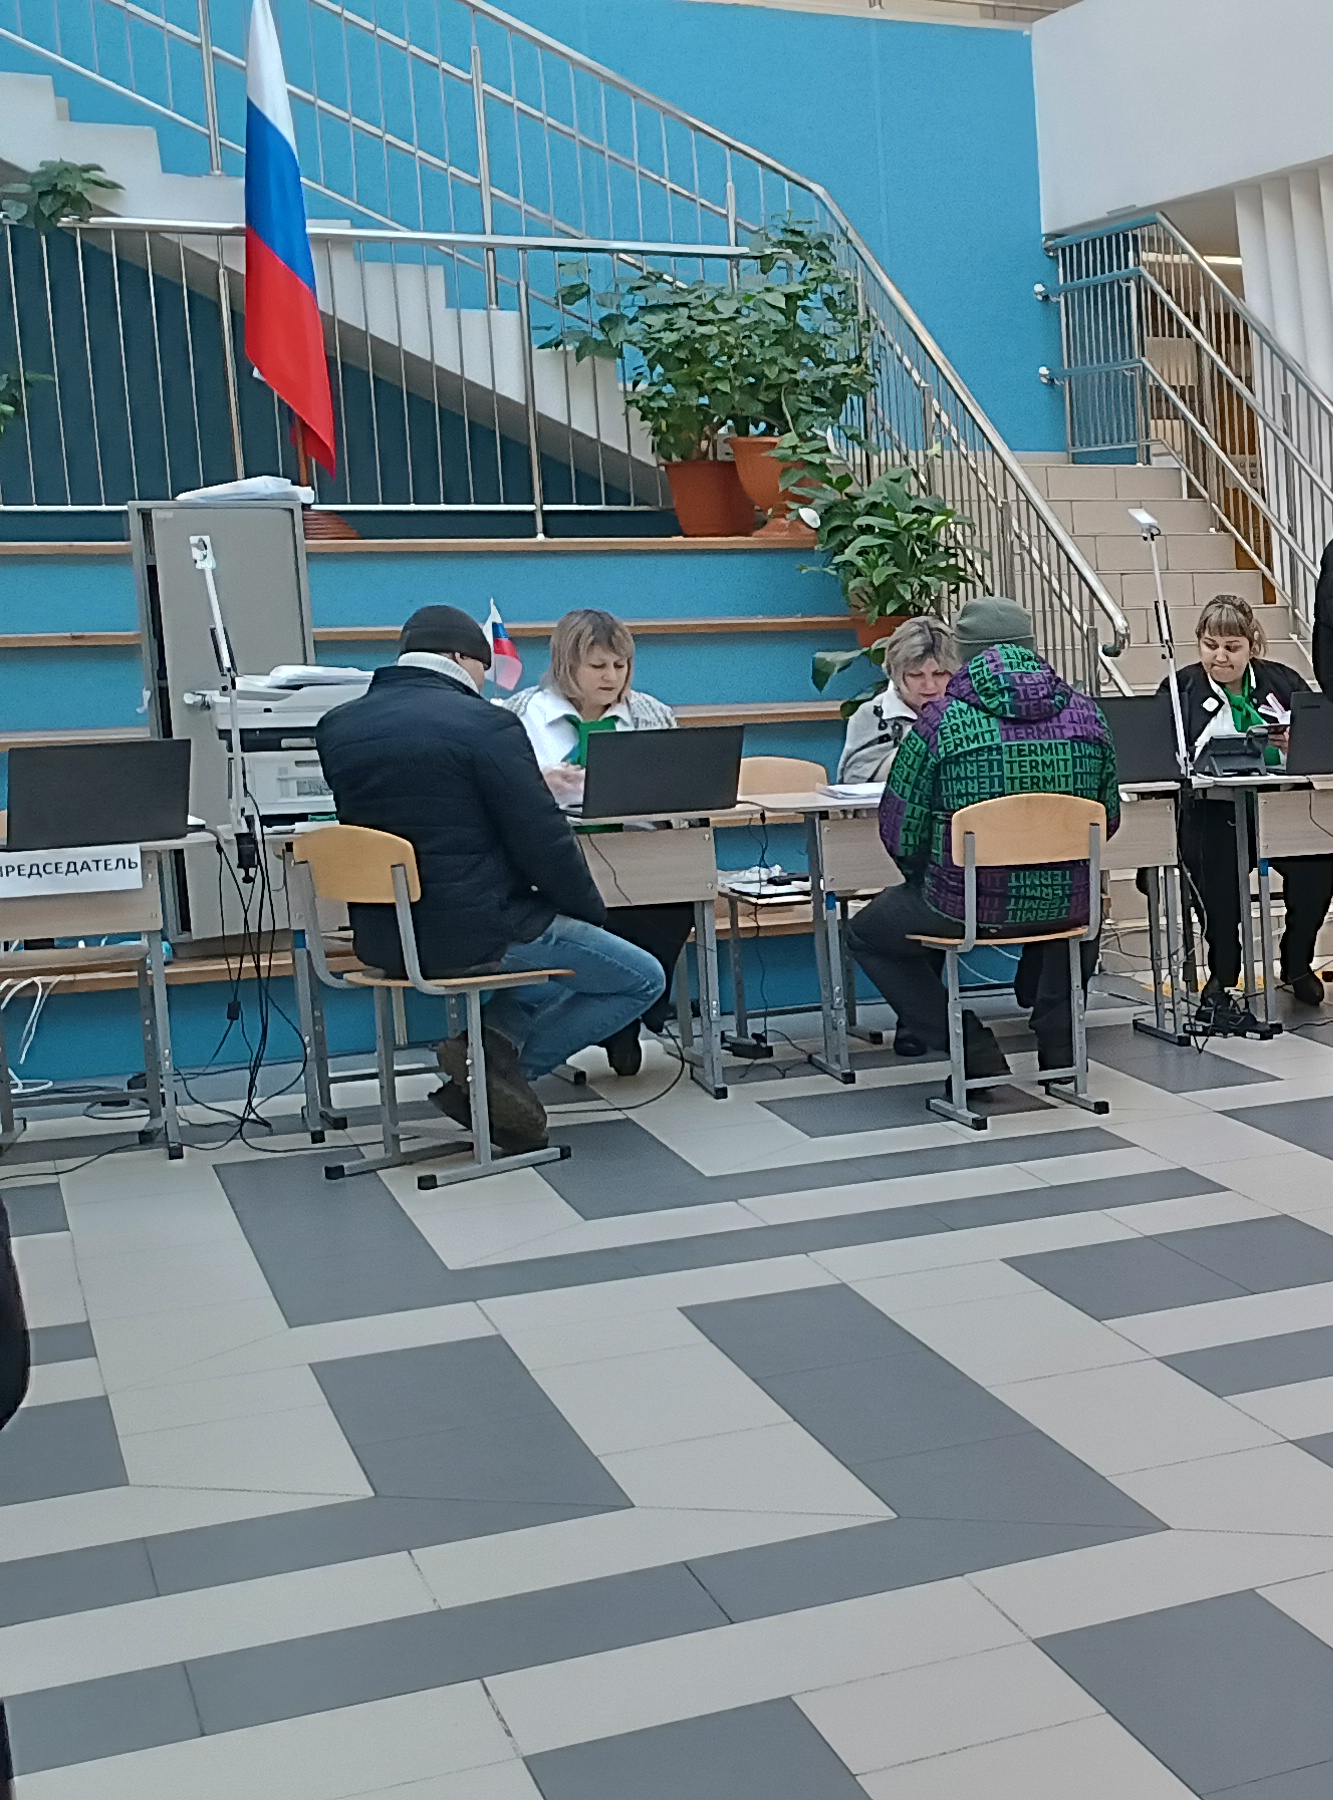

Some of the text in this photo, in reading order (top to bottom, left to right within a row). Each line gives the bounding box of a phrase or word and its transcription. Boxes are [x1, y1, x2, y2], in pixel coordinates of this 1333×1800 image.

[1001, 725, 1067, 740] TERMIT
[1004, 742, 1069, 758] TERMIT
[940, 761, 1003, 779] TERMIT
[1005, 758, 1070, 775] TERMIT
[941, 778, 1003, 796] TERMIT
[1006, 774, 1072, 791] TERMIT
[0, 857, 139, 879] РЕДСЕДАТЕЛЬ
[1007, 870, 1073, 886] TERMIT
[1004, 909, 1069, 923] TERMIT
